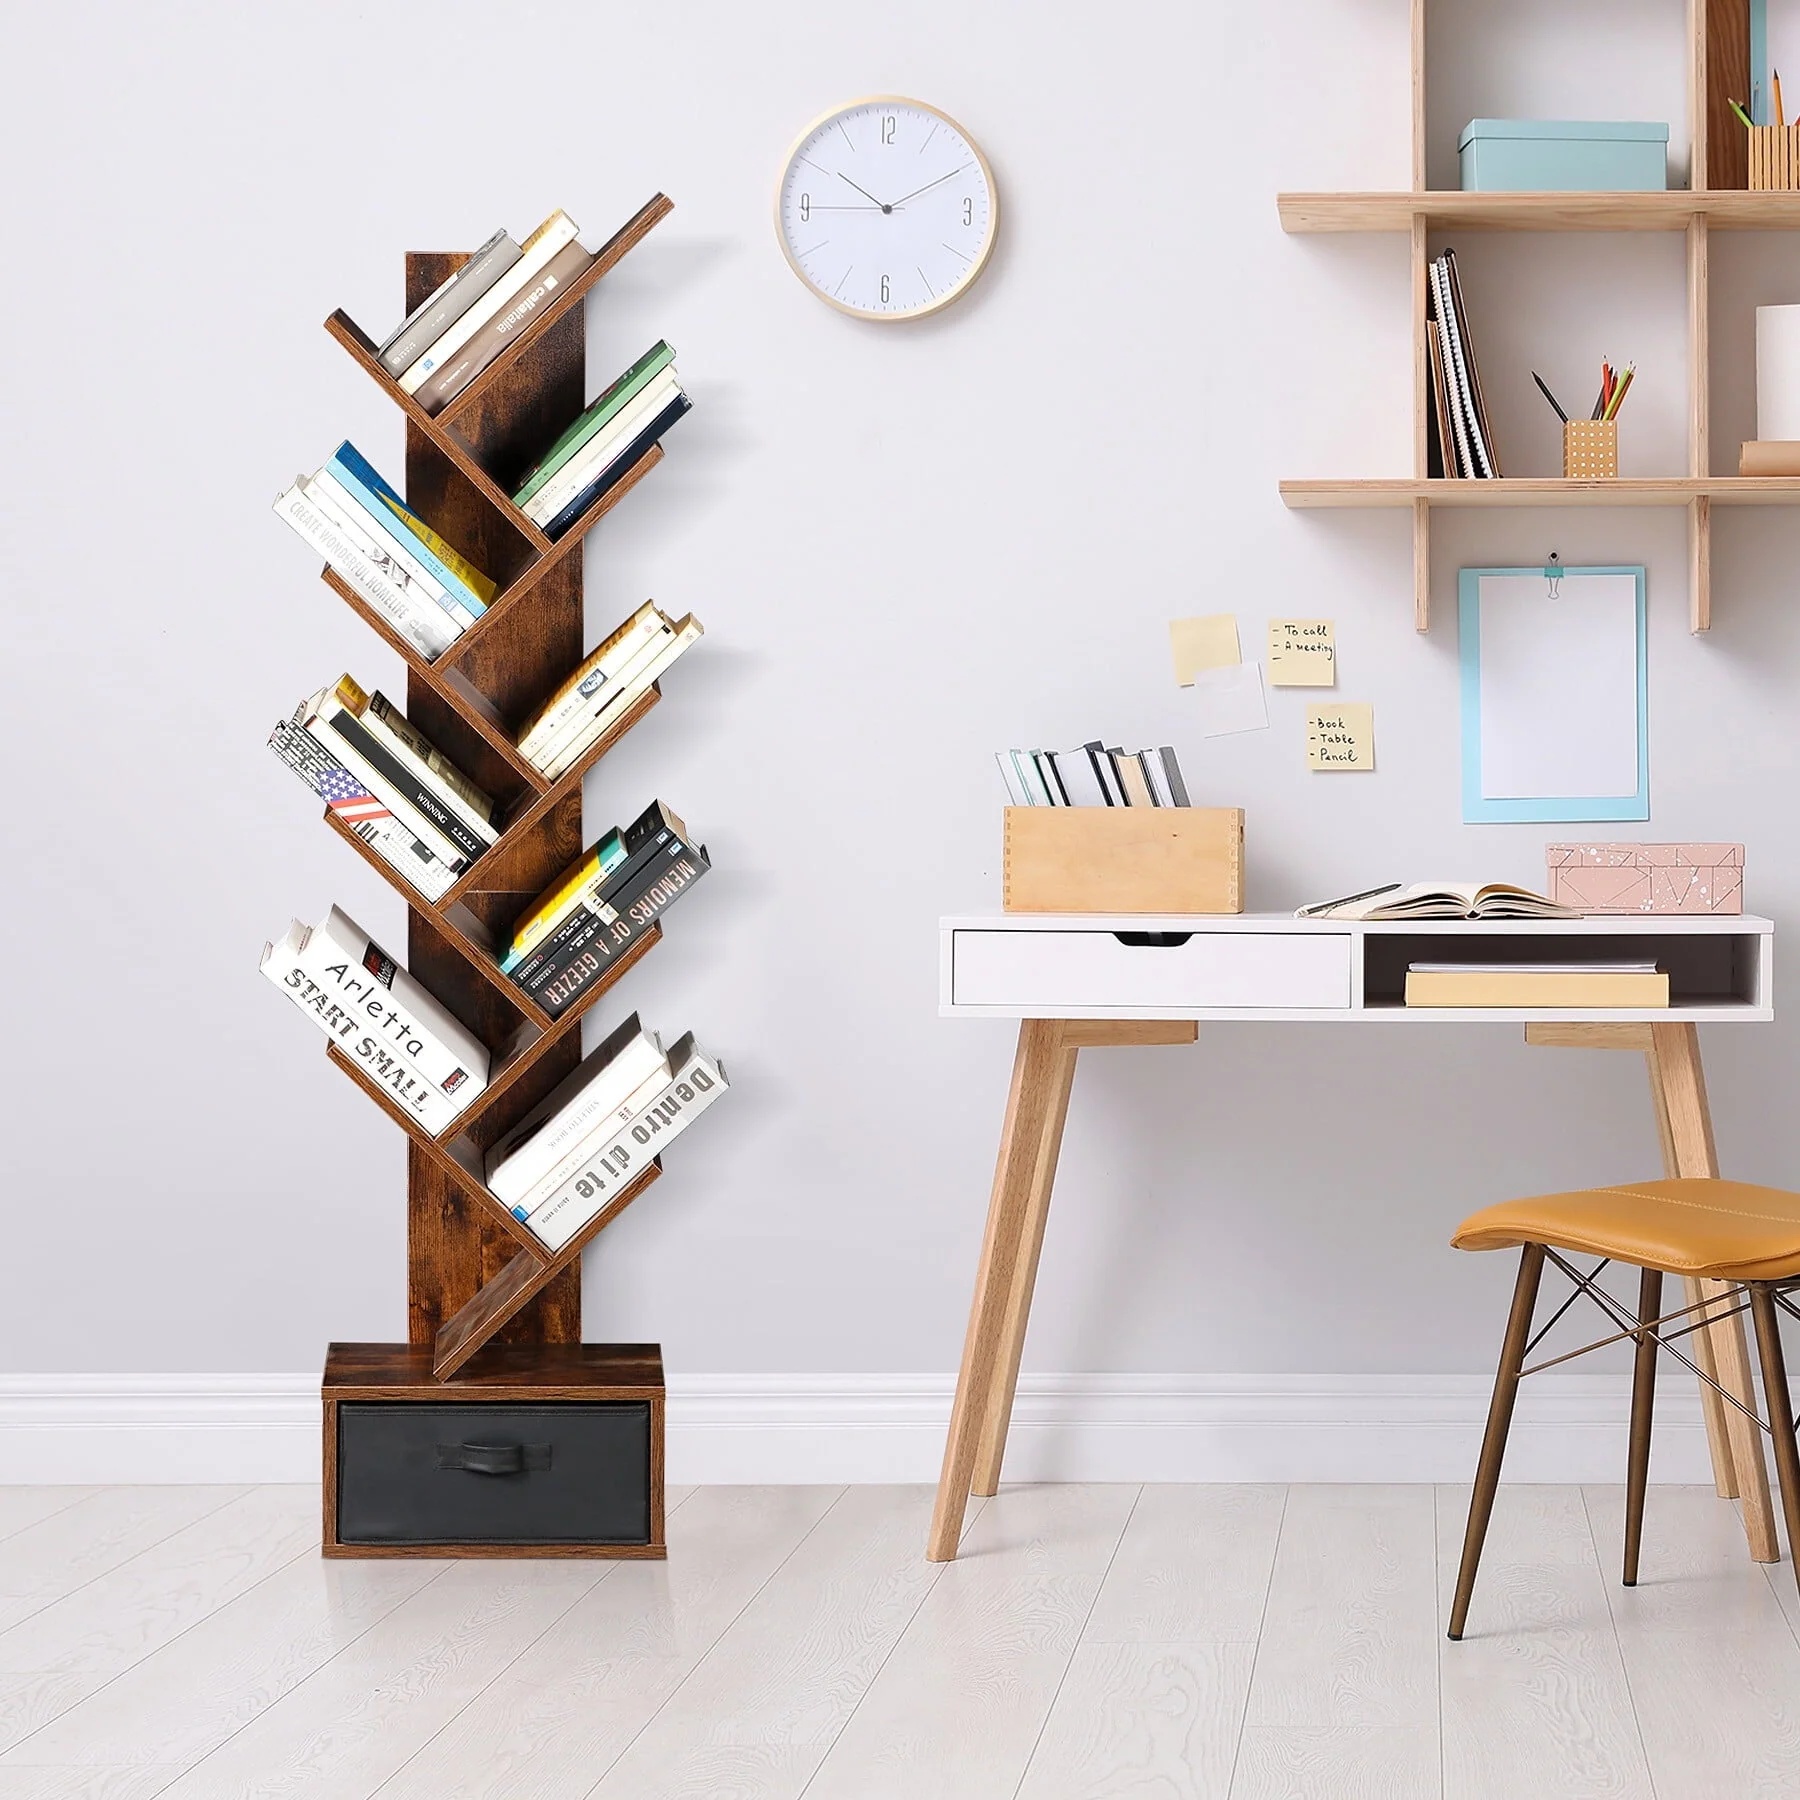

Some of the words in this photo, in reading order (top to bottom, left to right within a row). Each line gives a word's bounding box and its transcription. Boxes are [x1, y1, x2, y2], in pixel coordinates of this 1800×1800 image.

[881, 115, 896, 145] 12
[800, 193, 810, 222] 9
[962, 197, 972, 227] 3
[880, 274, 890, 304] 6
[496, 287, 546, 333] callaitalia
[289, 501, 323, 534] CREATE
[319, 529, 370, 584] WONDERFUL
[365, 575, 409, 620] HOMELIFE
[1284, 625, 1298, 636] To
[1303, 624, 1327, 637] call
[1285, 641, 1292, 651] A
[1296, 642, 1333, 661] meeting
[1317, 717, 1345, 729] Book
[1320, 733, 1355, 744] Table
[1320, 748, 1358, 762] Pencil
[416, 792, 448, 824] WINNING
[629, 859, 697, 925] MEMOIRS
[595, 939, 611, 956] A
[610, 920, 631, 945] OF
[544, 952, 599, 1005] GEEZER
[325, 965, 424, 1057] Arletta
[284, 968, 360, 1037] START
[355, 1037, 430, 1113] SMALL
[632, 1066, 715, 1145] Dentro
[599, 1144, 631, 1179] di
[574, 1171, 607, 1199] te
